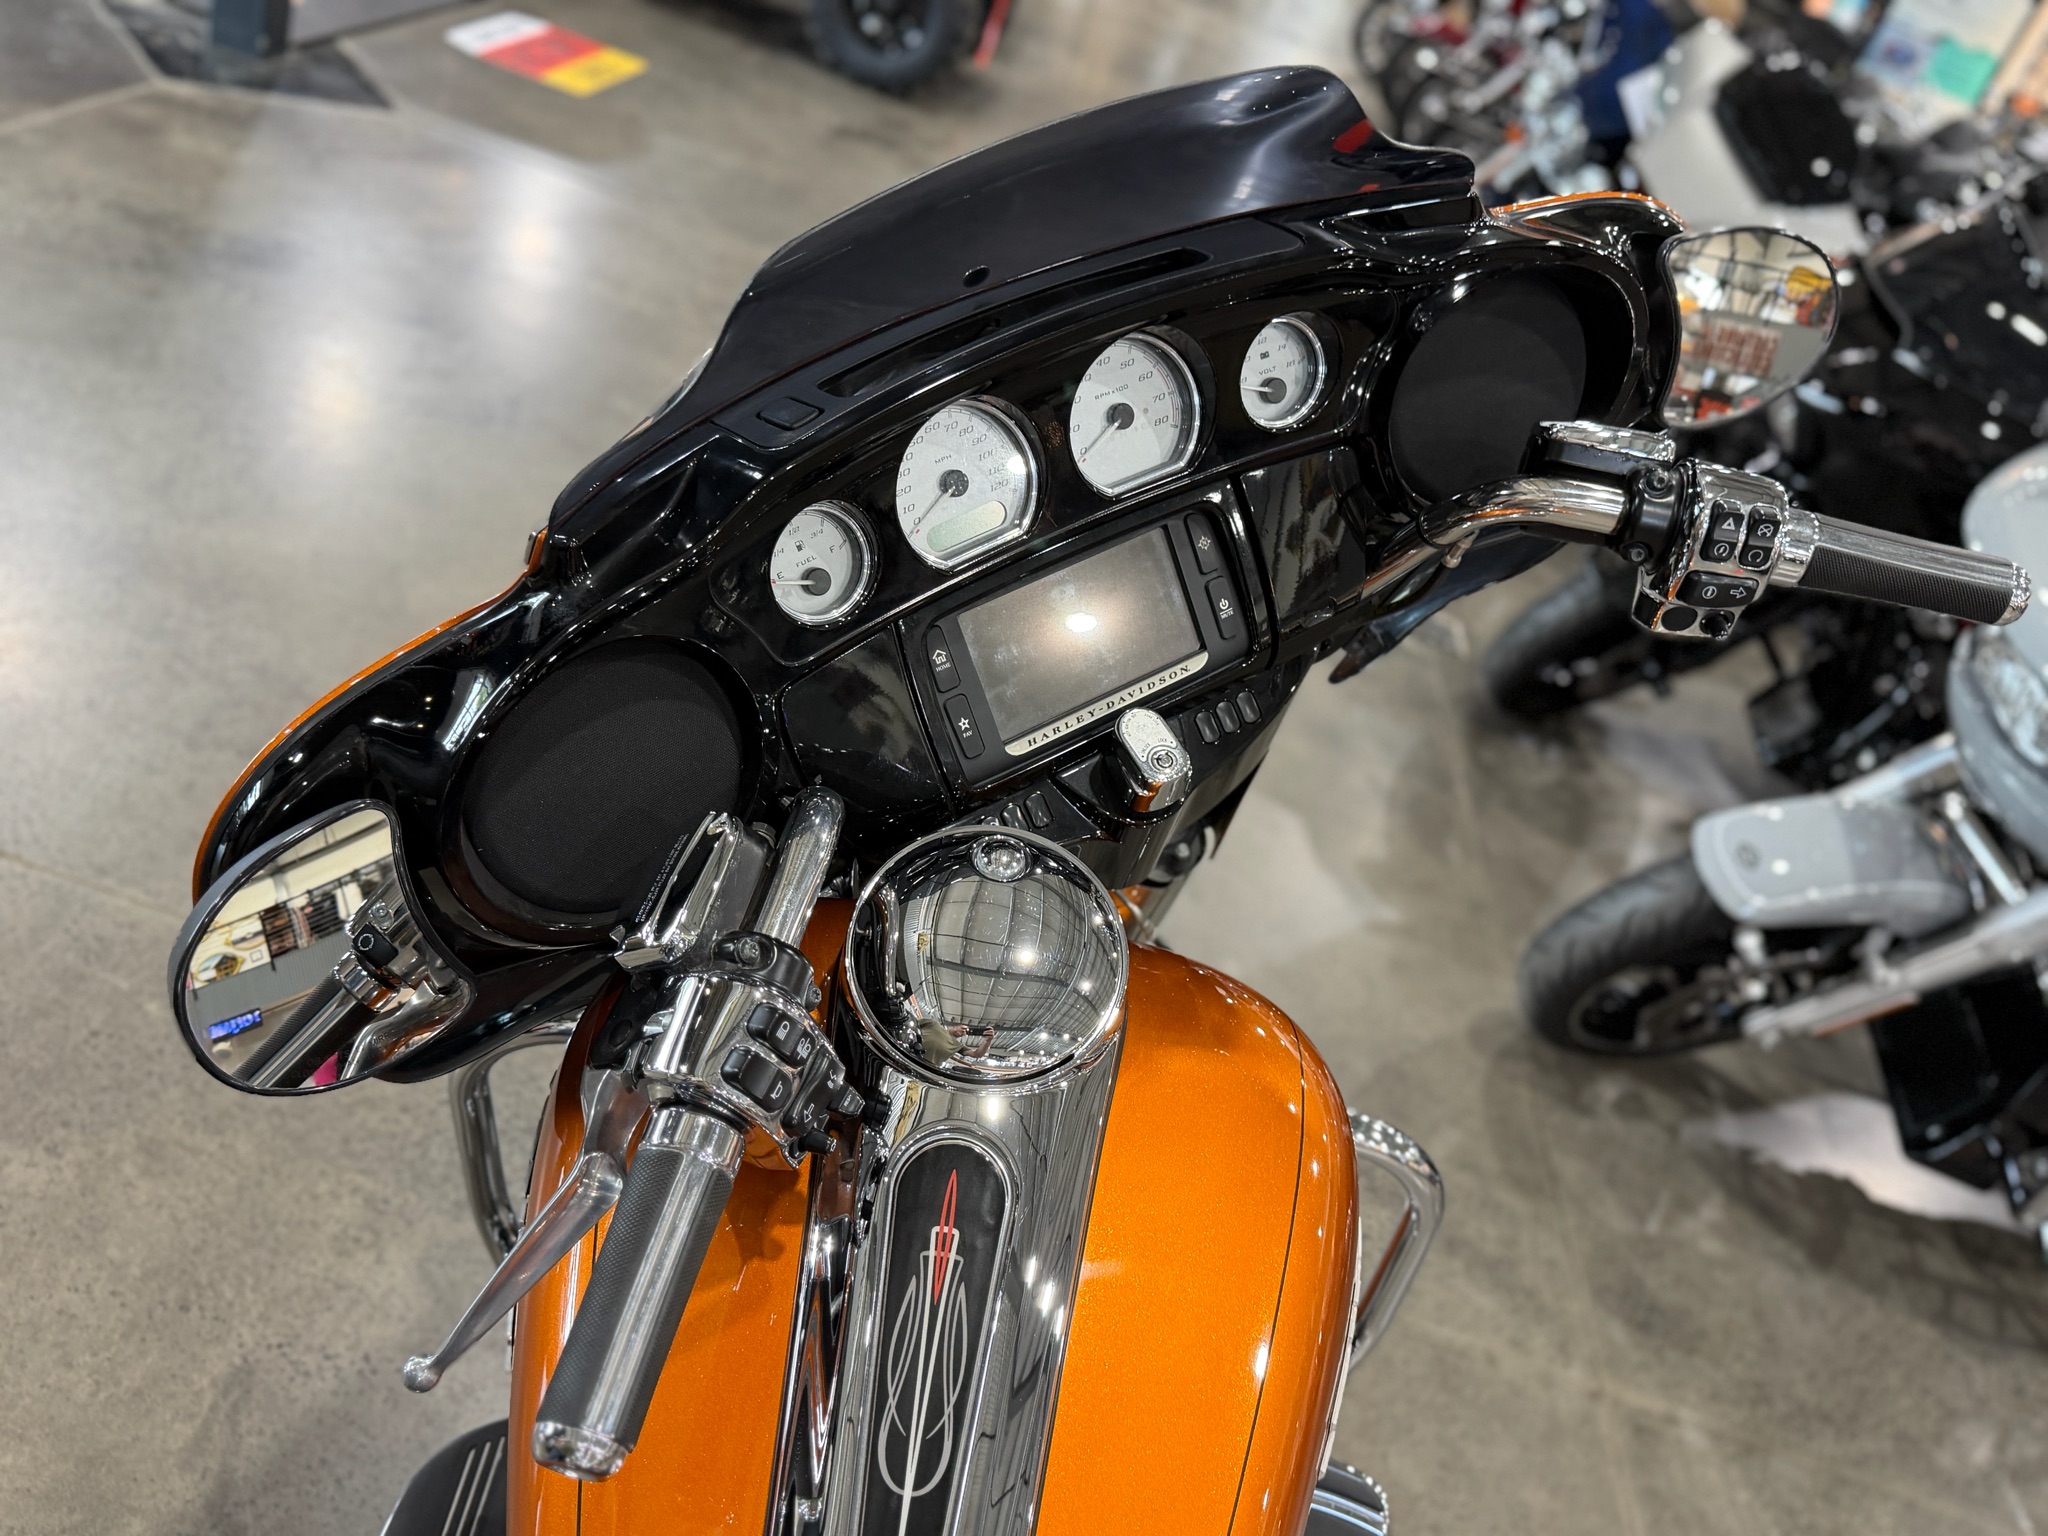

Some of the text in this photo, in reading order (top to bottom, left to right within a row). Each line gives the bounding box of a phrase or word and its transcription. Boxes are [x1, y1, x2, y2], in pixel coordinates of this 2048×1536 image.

[1120, 358, 1134, 370] 50
[1138, 371, 1153, 382] 60
[1258, 366, 1276, 376] VOLT
[1152, 392, 1166, 403] 70
[1154, 415, 1168, 426] 80
[924, 422, 940, 434] 60
[944, 421, 958, 432] 70
[960, 426, 974, 437] 80
[972, 434, 986, 446] 90
[1080, 446, 1088, 455] 0
[934, 454, 952, 464] MPH
[990, 479, 1008, 492] 120
[896, 486, 912, 497] 20
[903, 503, 915, 514] 10
[914, 516, 920, 526] 0
[829, 545, 836, 554] F
[796, 555, 816, 568] FUEL
[776, 571, 784, 580] E
[936, 662, 952, 672] HOME
[1027, 664, 1191, 748] HARLEY-DAVIDSON
[962, 730, 973, 738] FAV
